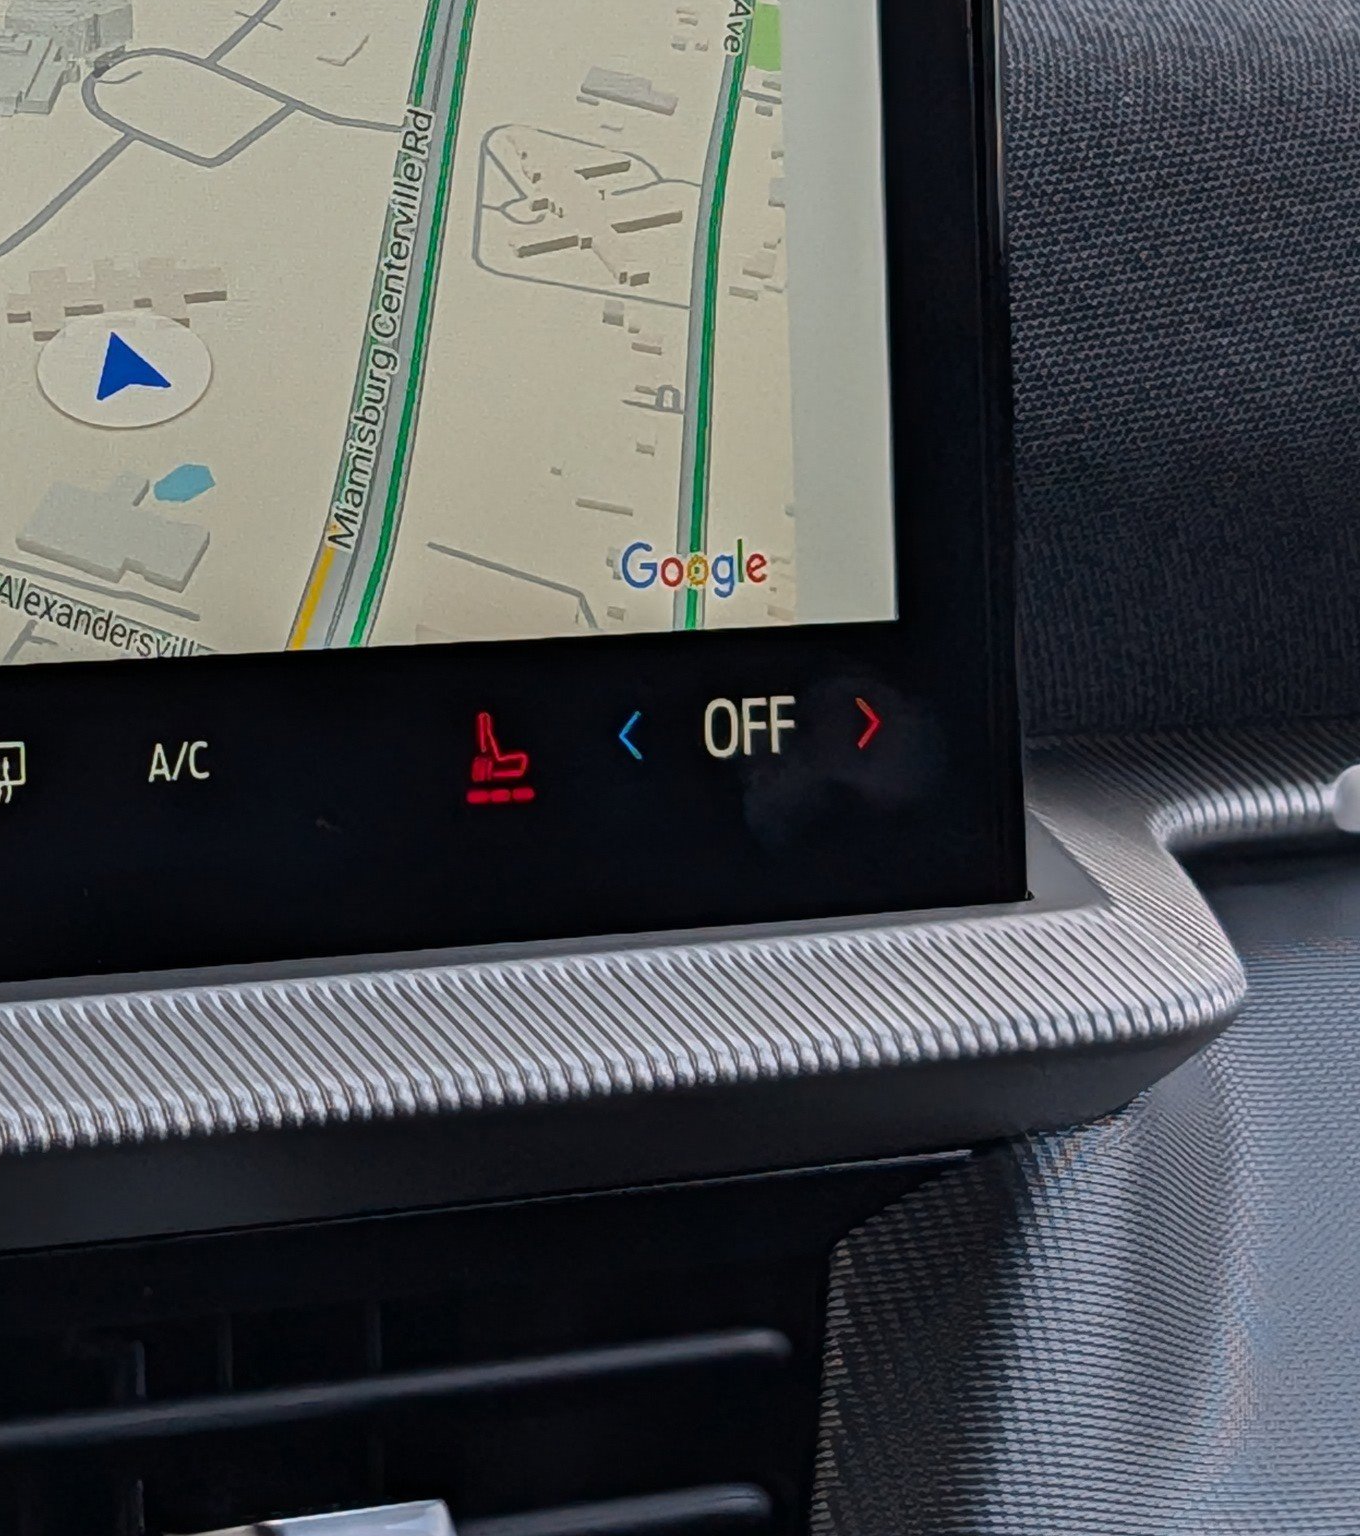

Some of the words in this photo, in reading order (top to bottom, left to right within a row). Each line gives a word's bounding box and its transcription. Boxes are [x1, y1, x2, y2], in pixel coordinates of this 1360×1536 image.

[327, 346, 397, 549] Miamisburg
[372, 158, 423, 339] Centerville
[403, 108, 433, 157] Rd
[622, 538, 767, 598] Google
[704, 694, 796, 758] OFF
[149, 741, 210, 782] A/C
